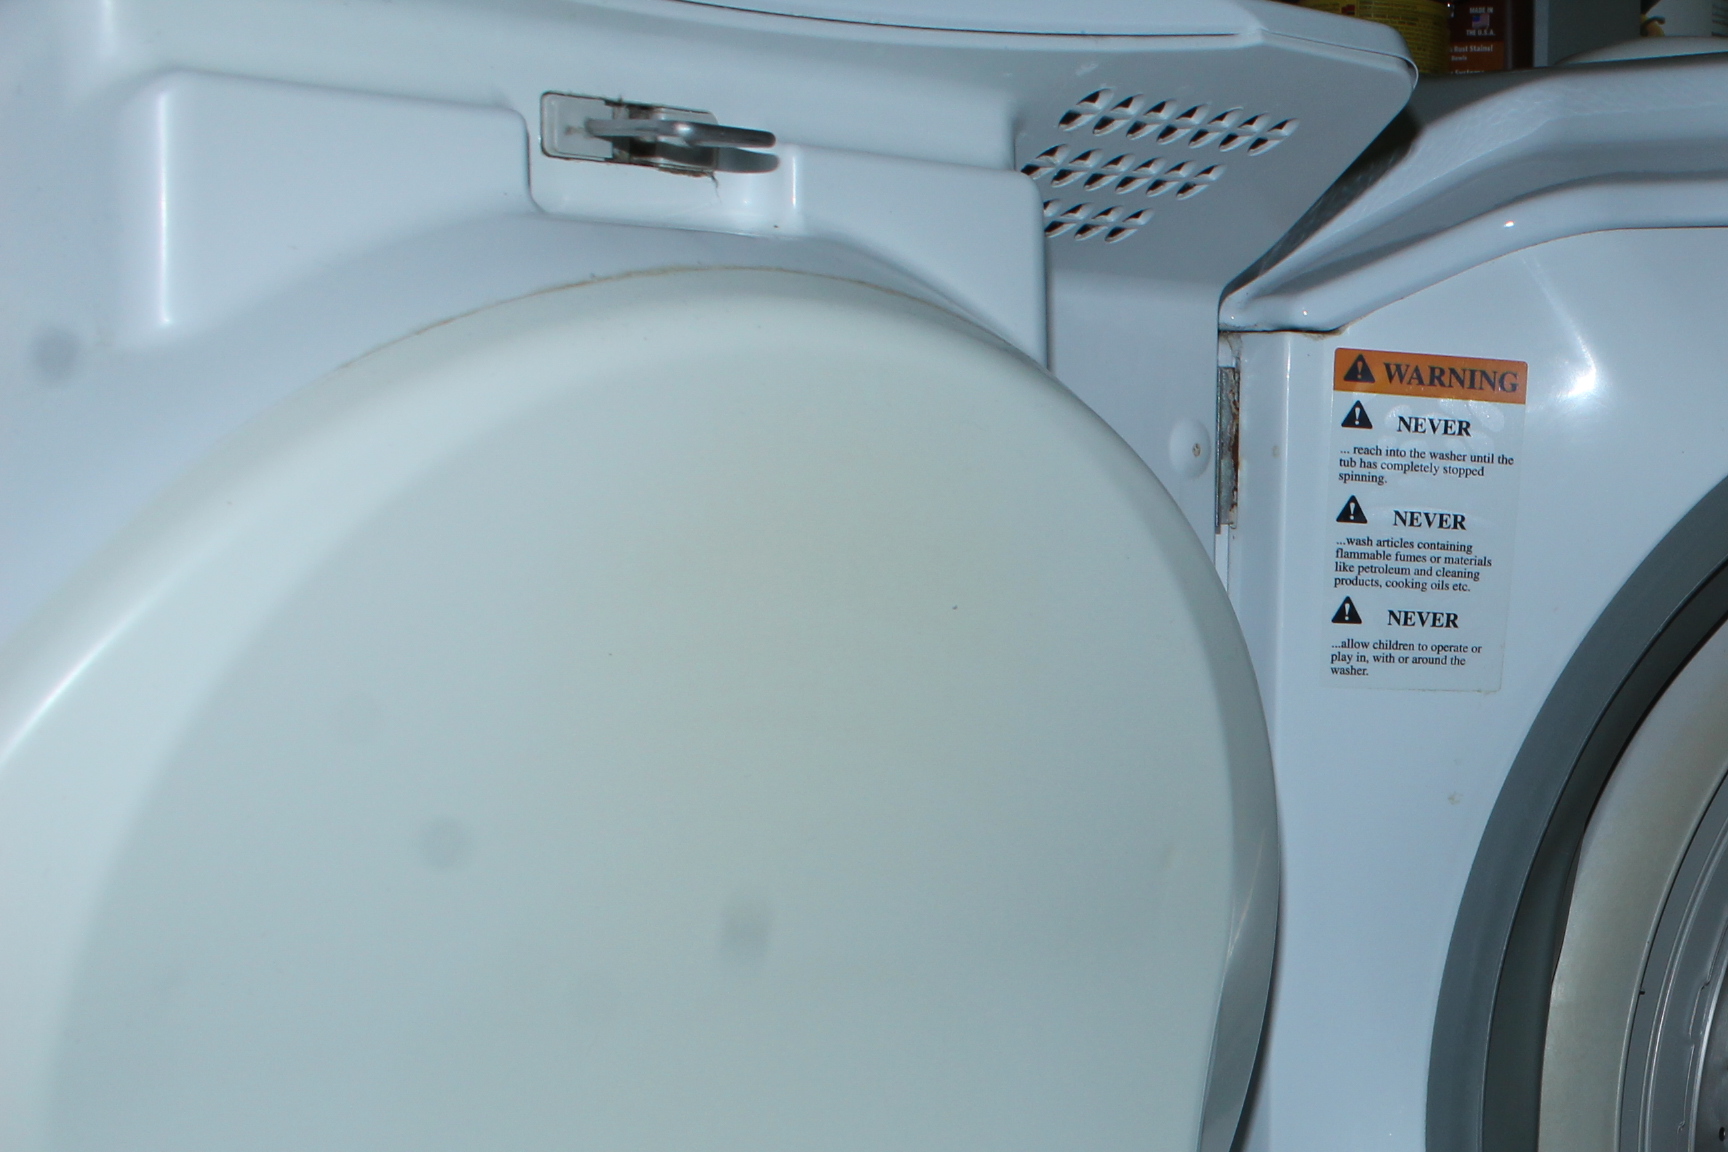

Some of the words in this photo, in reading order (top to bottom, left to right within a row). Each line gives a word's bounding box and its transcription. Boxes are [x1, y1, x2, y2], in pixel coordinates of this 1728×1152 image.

[1383, 361, 1519, 393] WARNING
[1396, 415, 1472, 437] NEVER
[1353, 445, 1382, 457] reach
[1385, 446, 1407, 458] into
[1409, 448, 1426, 459] the
[1429, 450, 1468, 463] washer
[1470, 453, 1494, 464] until
[1497, 454, 1515, 466] the
[1339, 457, 1357, 468] tub
[1359, 458, 1378, 470] has
[1380, 461, 1440, 476] completely
[1442, 465, 1485, 478] stopped
[1338, 471, 1388, 486] spinning.
[1392, 510, 1467, 531] NEVER
[1376, 537, 1415, 549] articles
[1417, 541, 1473, 555] containing
[1335, 547, 1392, 561] flammable
[1395, 550, 1427, 563] fumes
[1429, 555, 1442, 564] or
[1444, 555, 1493, 567] materials
[1335, 561, 1355, 573] like
[1357, 564, 1411, 576] petroleum
[1413, 566, 1433, 577] and
[1435, 567, 1480, 582] cleaning
[1333, 576, 1382, 588] products,
[1385, 578, 1427, 593] cooking
[1430, 580, 1450, 592] oils
[1452, 582, 1471, 592] etc.
[1387, 609, 1460, 630] NEVER
[1372, 639, 1415, 651] children
[1418, 642, 1428, 652] to
[1430, 644, 1469, 655] operate
[1471, 645, 1483, 654] or
[1330, 650, 1353, 665] play
[1356, 652, 1369, 664] in,
[1372, 653, 1395, 664] with
[1398, 655, 1410, 664] or
[1411, 655, 1448, 666] around
[1450, 655, 1466, 666] the
[1330, 665, 1369, 676] washer.
